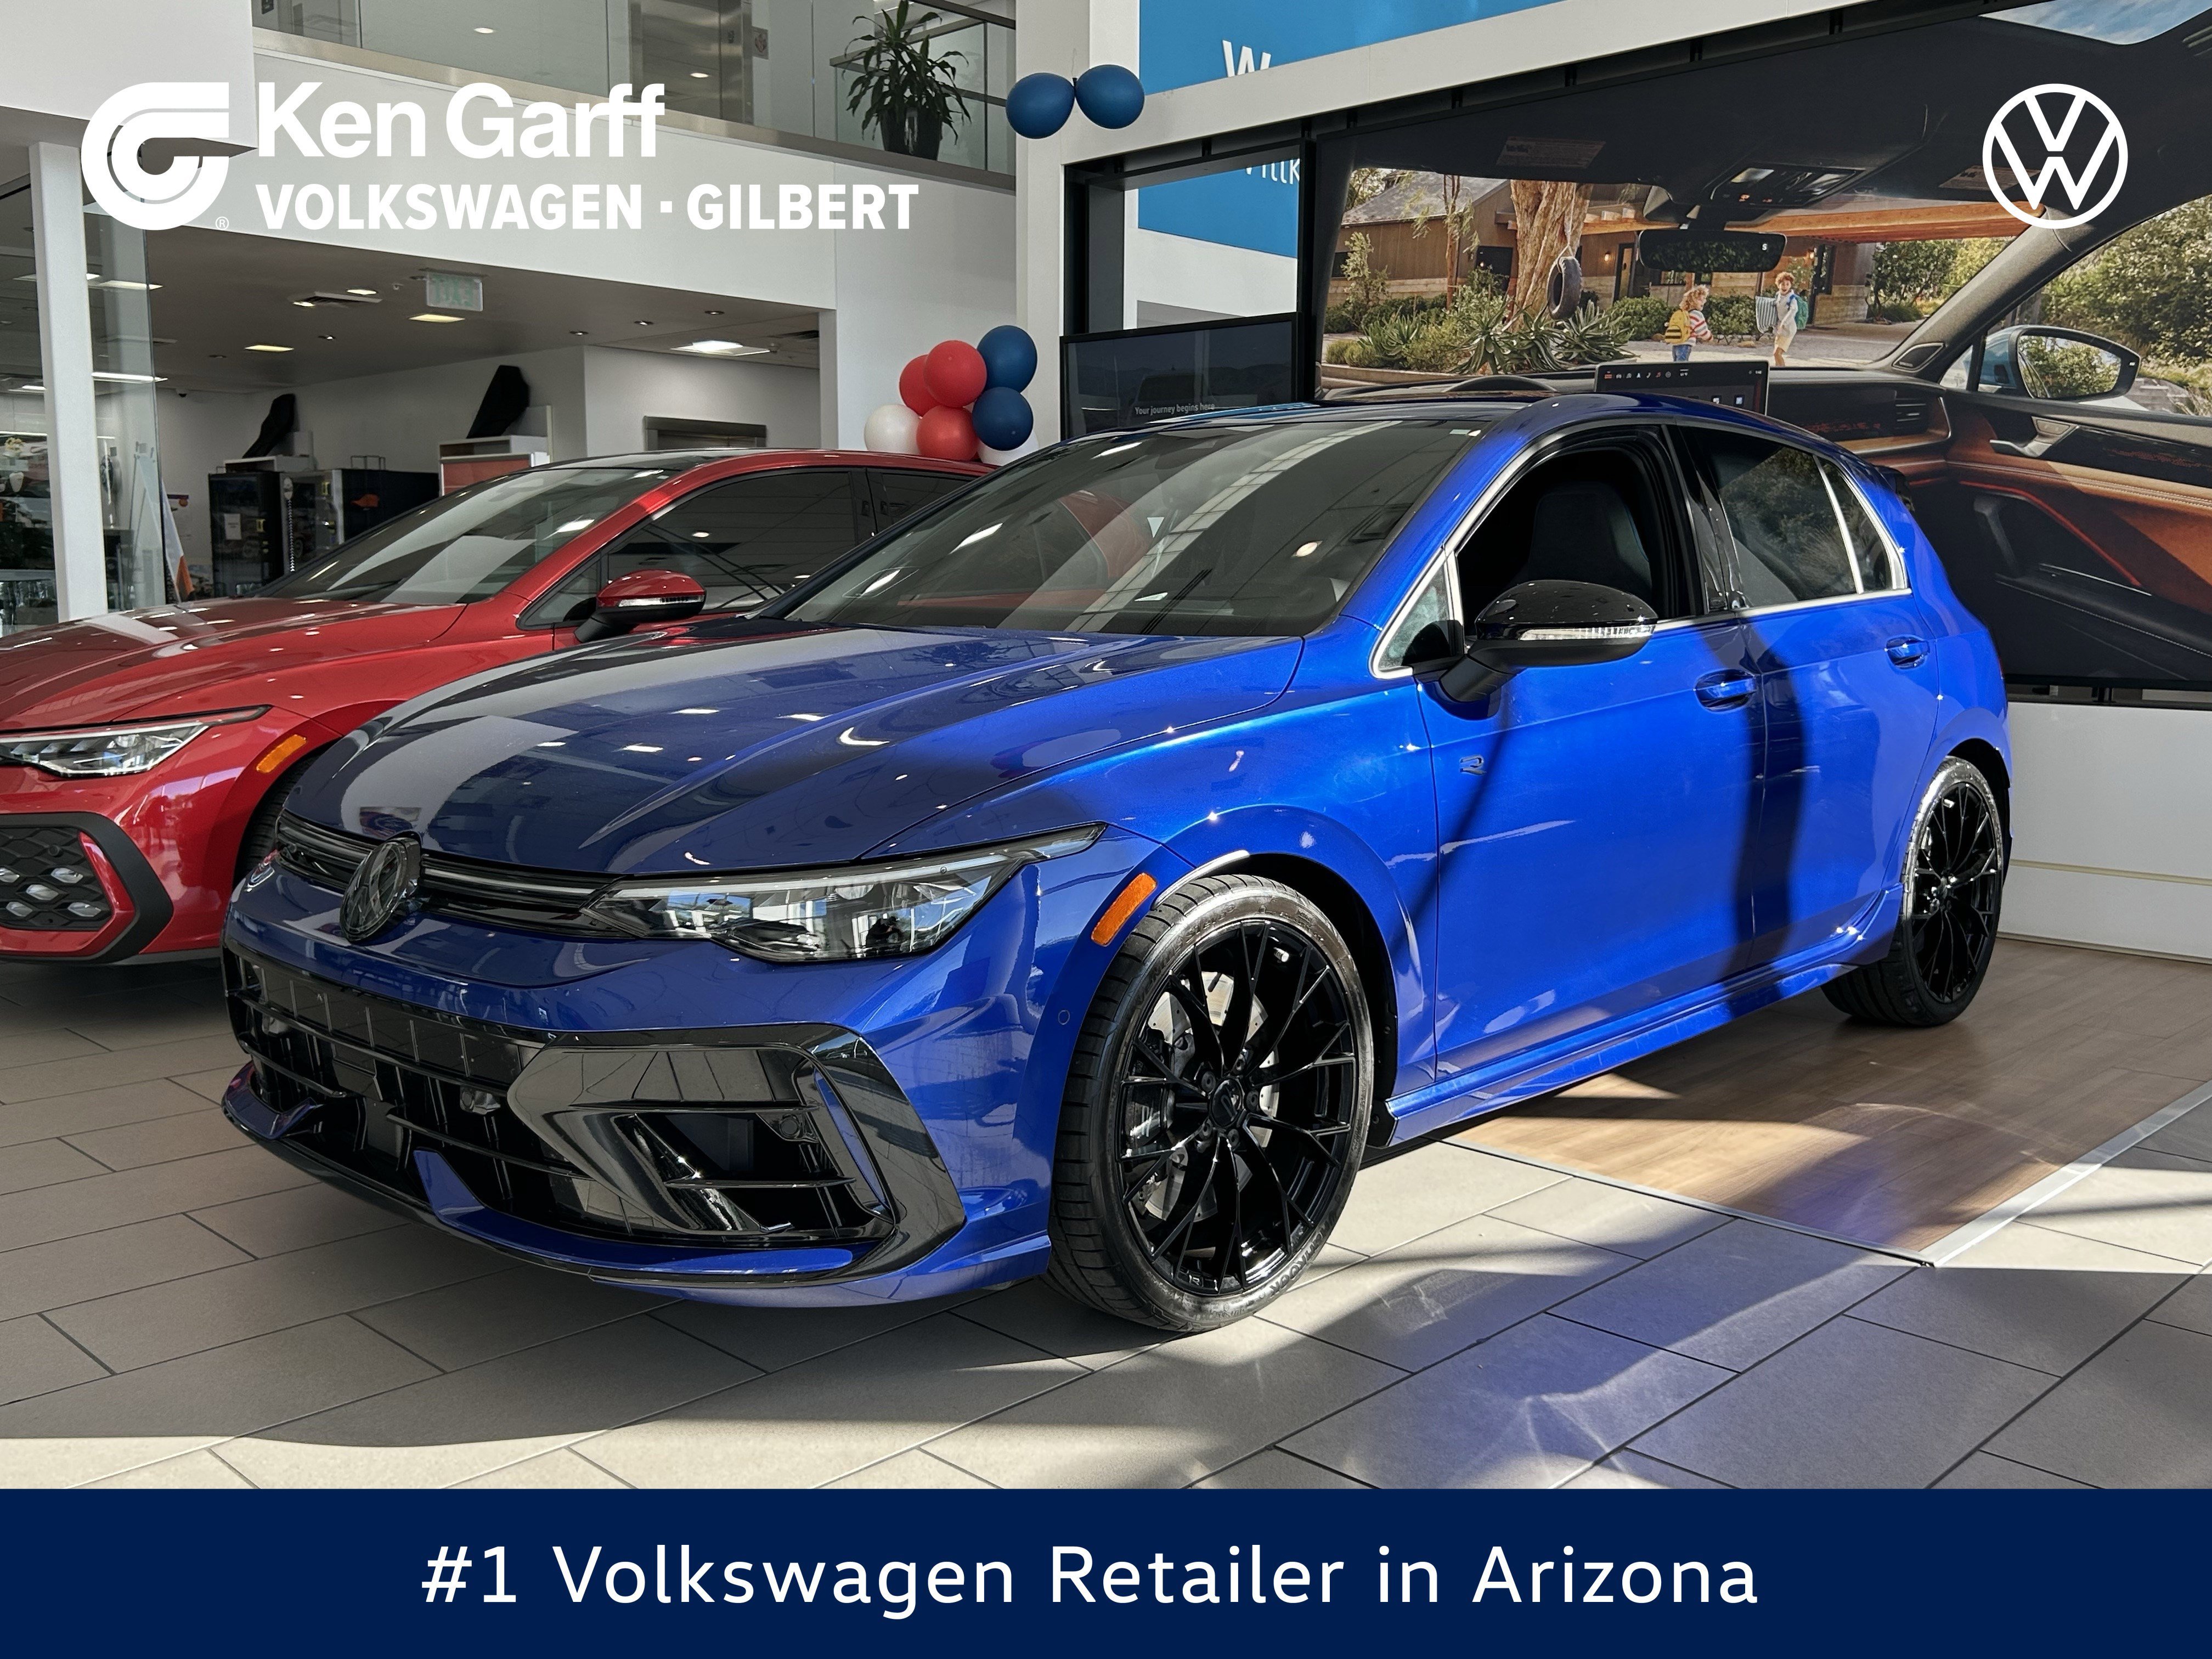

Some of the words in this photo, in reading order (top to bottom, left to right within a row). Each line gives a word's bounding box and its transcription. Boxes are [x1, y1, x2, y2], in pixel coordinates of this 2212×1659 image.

[1246, 158, 1300, 185] illk
[1135, 407, 1150, 415] Your
[1150, 405, 1176, 416] journey
[1176, 403, 1199, 414] begins
